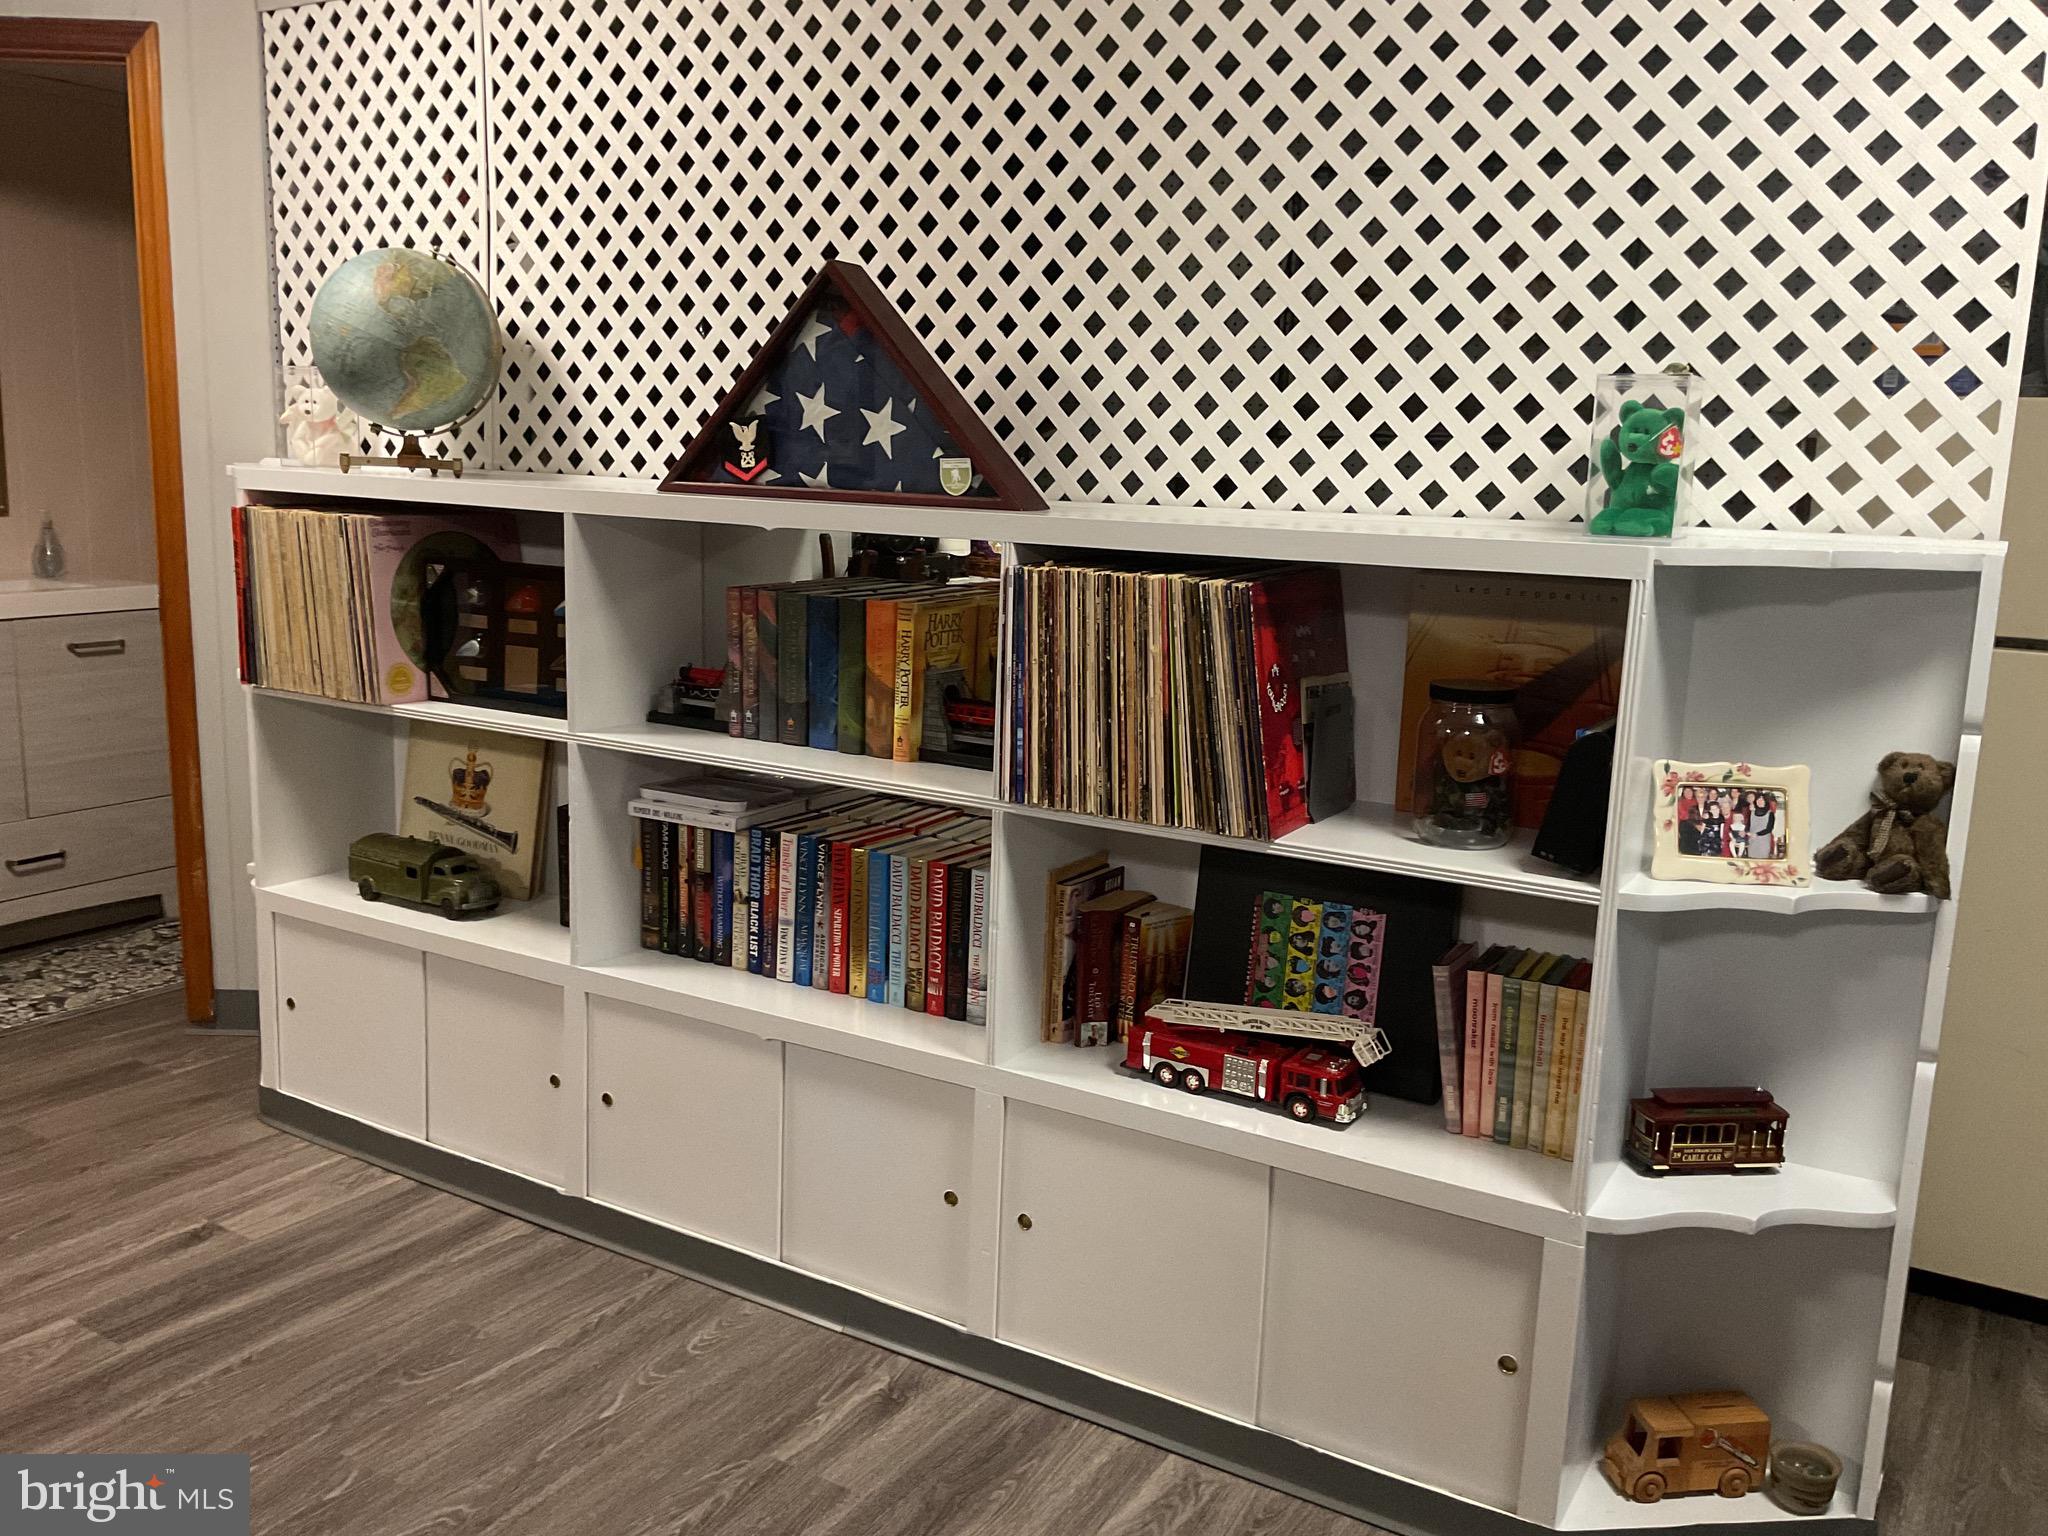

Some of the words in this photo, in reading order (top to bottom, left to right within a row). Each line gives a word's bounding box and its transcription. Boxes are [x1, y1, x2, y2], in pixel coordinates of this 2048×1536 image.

[928, 613, 963, 631] HARRY
[901, 629, 912, 665] HARRY
[924, 628, 966, 650] POTTER
[899, 668, 911, 709] POTTER
[661, 842, 669, 870] HOAG
[751, 829, 761, 862] BRAD
[782, 838, 794, 873] Transfer
[799, 841, 808, 873] VINCE
[816, 843, 826, 879] VINCE
[751, 865, 761, 898] THOR
[782, 874, 793, 885] of
[854, 853, 865, 883] VINCE
[891, 860, 903, 892] DAVID
[910, 866, 922, 902] DAVID
[952, 871, 963, 898] DAVID
[716, 875, 724, 911] WITHOUT
[781, 886, 792, 912] Power
[798, 877, 808, 913] FLYNN
[816, 881, 826, 917] FLYNN
[930, 868, 944, 907] DAVID
[974, 875, 985, 903] DAVID
[750, 901, 759, 933] BLACK
[853, 887, 865, 923] FLYNN
[891, 893, 902, 945] BALDACCI
[716, 913, 724, 949] WARNING
[780, 928, 789, 945] VINCE
[833, 907, 842, 947] SEPARATION
[868, 902, 882, 964] BALDACCI
[909, 904, 922, 962] BALDACCI
[951, 900, 962, 944] BALDACCI
[972, 905, 984, 948] BALDACCI
[750, 935, 758, 957] LIST
[779, 945, 788, 964] FLYNN
[929, 911, 943, 974] BALDACCI
[1129, 936, 1139, 973] TRUST
[832, 953, 841, 977] POWER
[891, 950, 901, 969] THE
[891, 971, 901, 988] HIT
[1127, 974, 1137, 992] NO
[1087, 981, 1097, 1018] TOLSTOY
[1094, 992, 1102, 1008] LEO
[1124, 995, 1135, 1021] ONE
[1491, 1002, 1499, 1021] from
[1470, 998, 1479, 1049] moonraker
[1504, 1037, 1513, 1050] no
[1535, 1014, 1548, 1067] thunderball
[1682, 1153, 1705, 1162] CABLE
[1707, 1153, 1722, 1162] CAR
